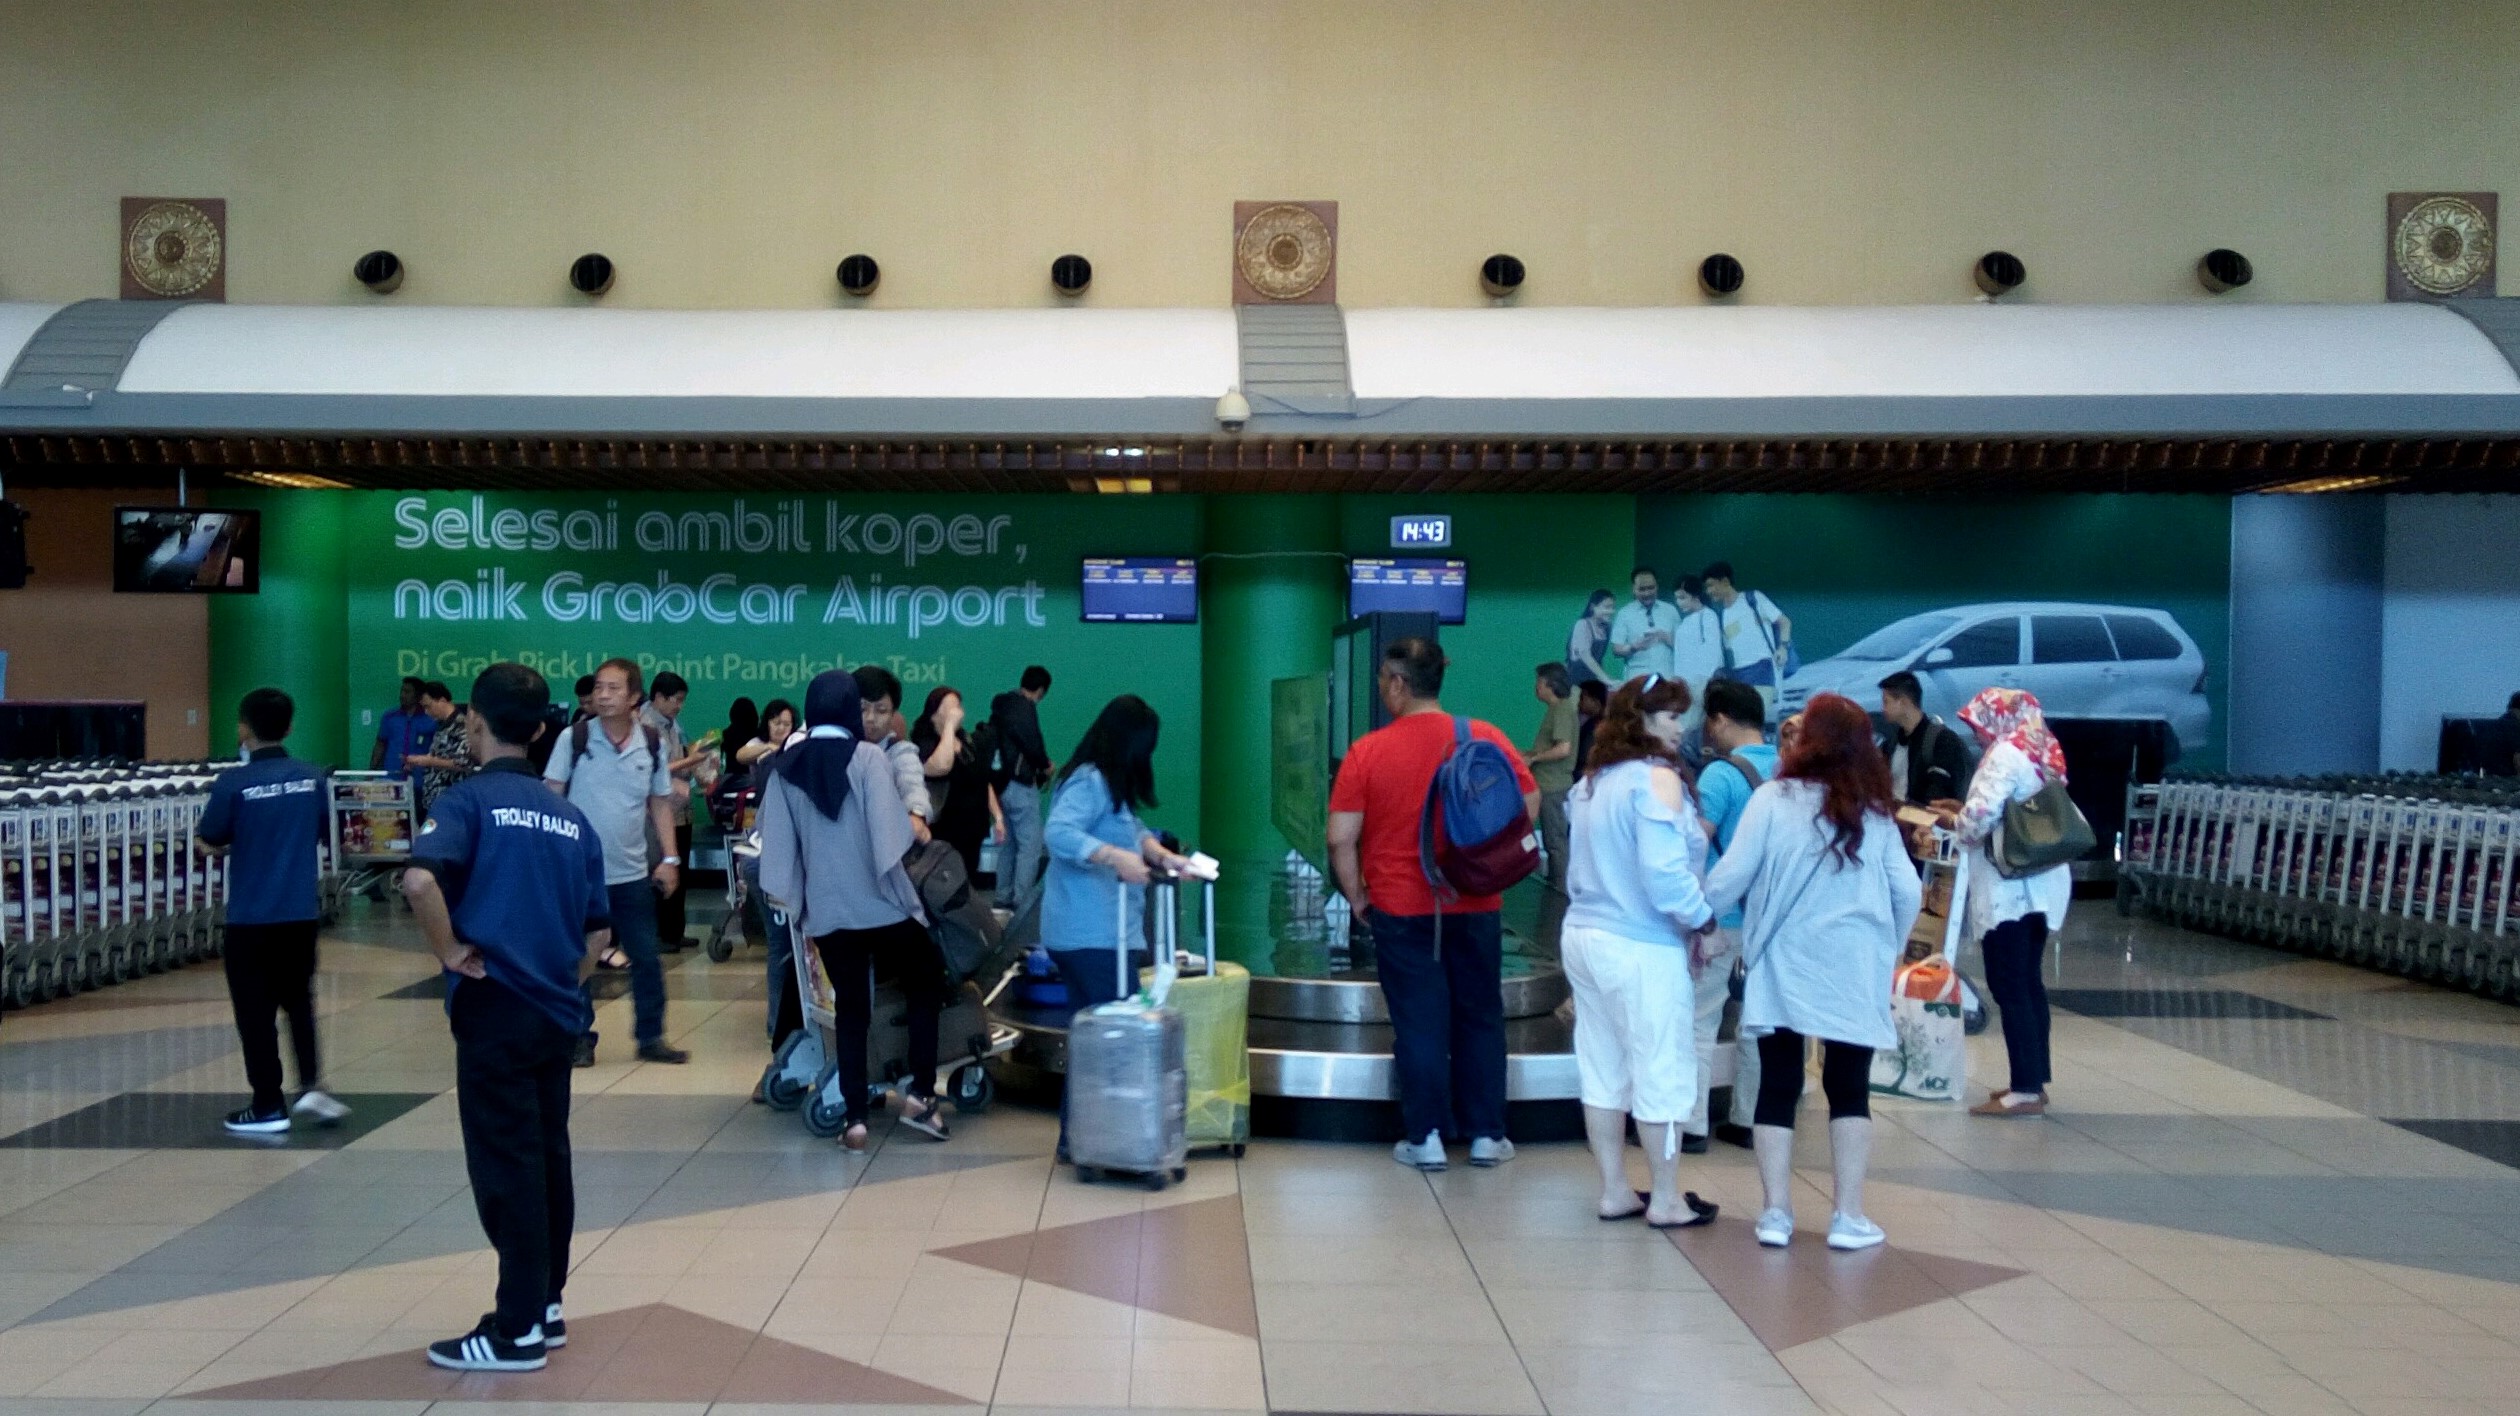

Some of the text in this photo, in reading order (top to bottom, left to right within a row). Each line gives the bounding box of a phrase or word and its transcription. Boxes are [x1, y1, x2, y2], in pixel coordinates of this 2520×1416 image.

[394, 495, 1028, 567] Selesai ambil koper,
[1402, 520, 1445, 542] 14:43
[394, 566, 1046, 639] naik GrabCar Airport
[397, 649, 430, 677] Di
[518, 649, 579, 679] Pick
[638, 651, 715, 681] Point
[886, 654, 946, 683] Taxi
[491, 807, 540, 829] TROLLEY
